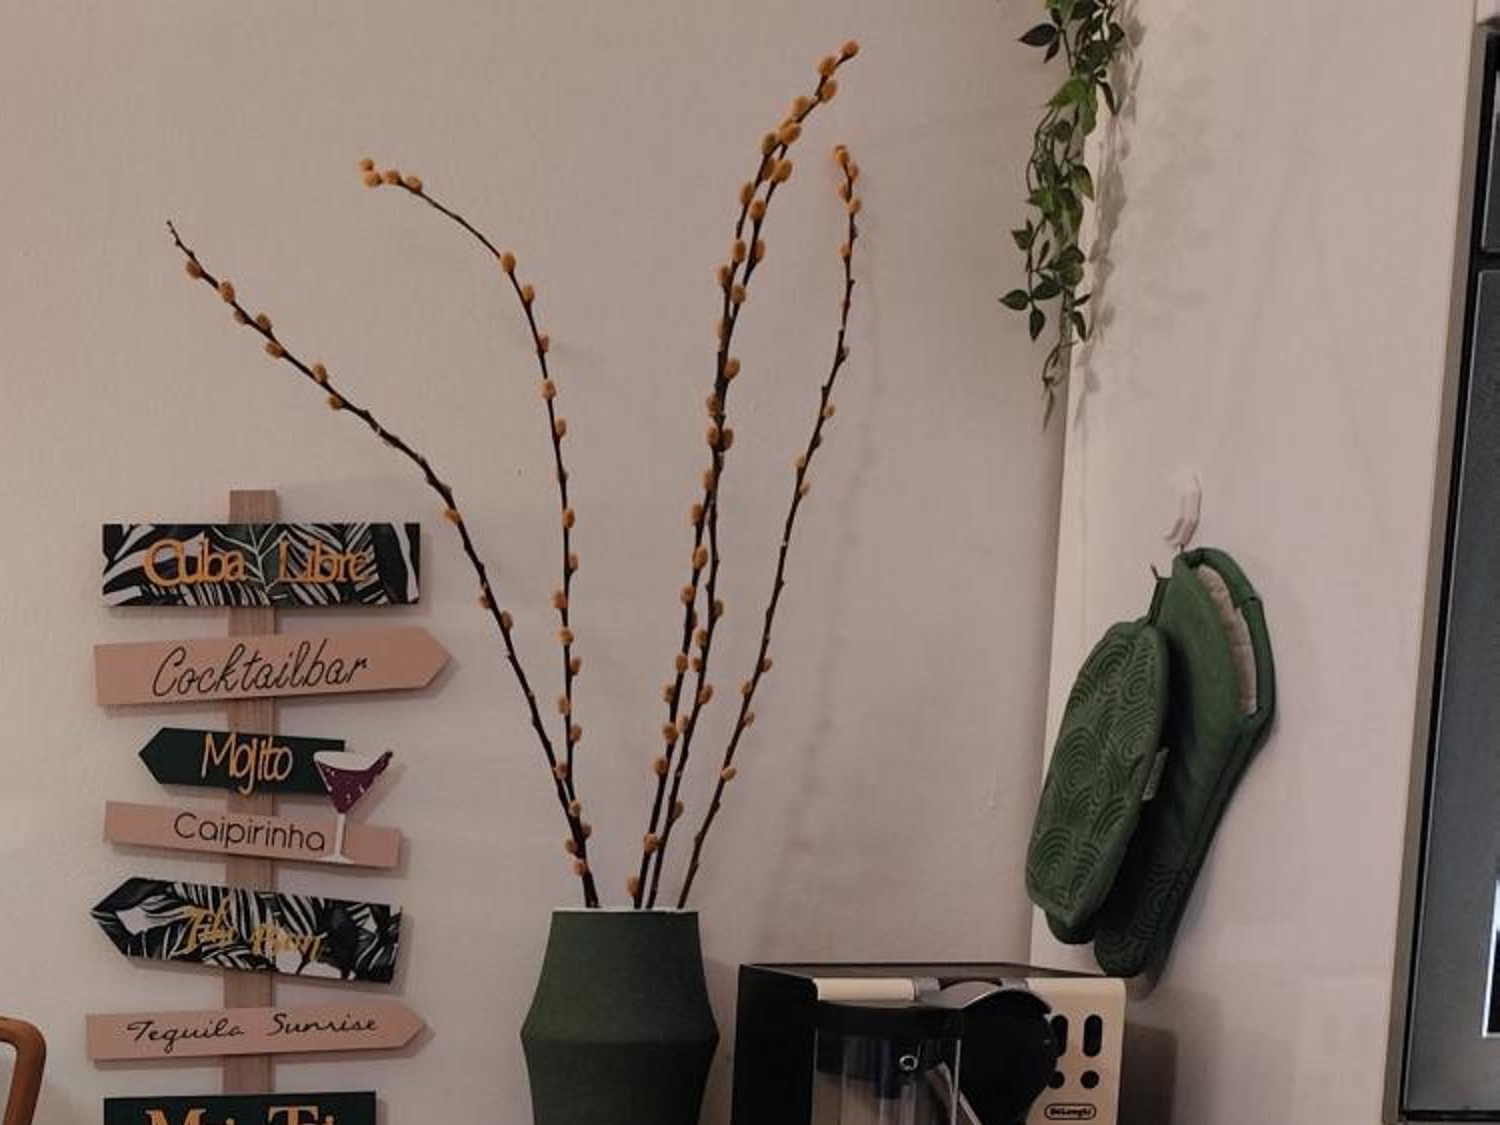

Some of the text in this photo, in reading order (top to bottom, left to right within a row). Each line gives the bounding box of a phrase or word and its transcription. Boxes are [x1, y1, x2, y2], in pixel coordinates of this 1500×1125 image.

[141, 531, 372, 588] Cuba Libre
[151, 638, 368, 697] Cocktailbar
[201, 733, 293, 795] Mojito
[173, 811, 326, 853] Caipirinha
[127, 1013, 378, 1054] Tequila Sunrise
